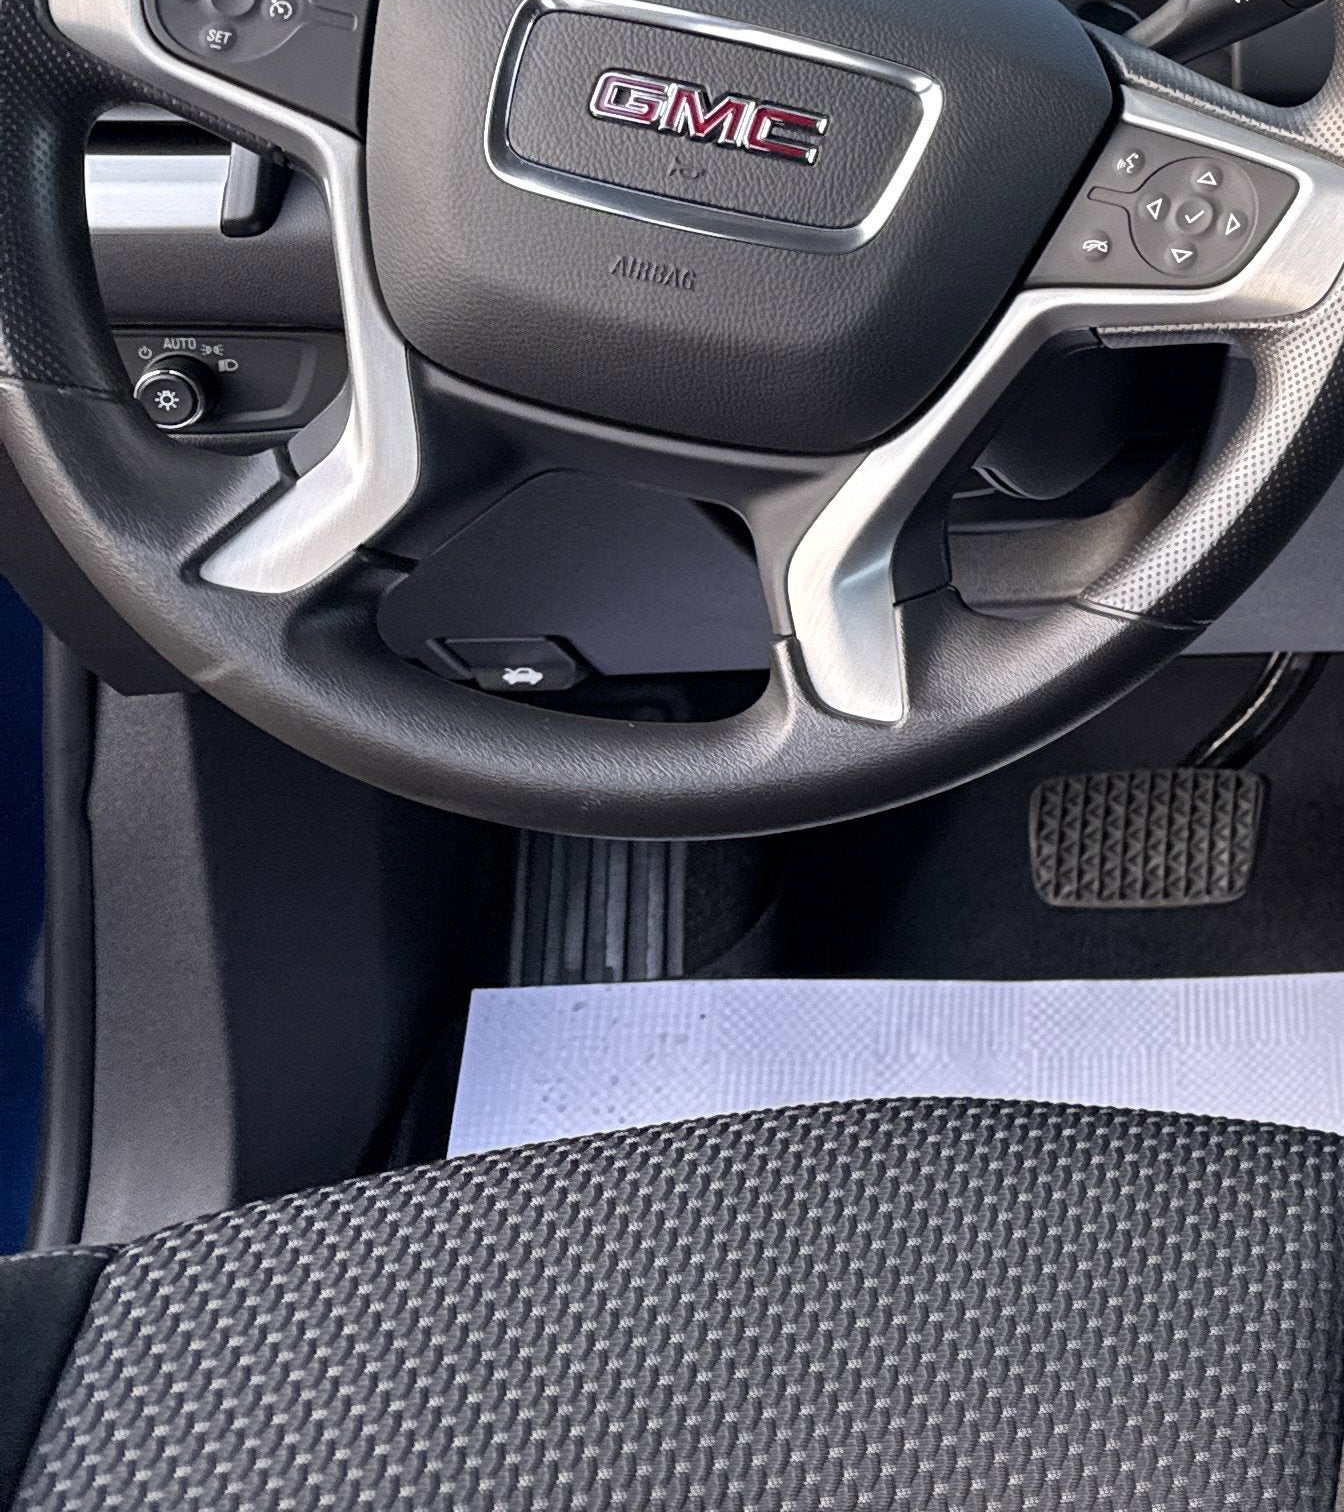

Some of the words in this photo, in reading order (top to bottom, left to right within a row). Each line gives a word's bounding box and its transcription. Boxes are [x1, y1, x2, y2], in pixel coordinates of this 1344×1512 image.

[206, 28, 233, 45] SET
[589, 70, 831, 166] GMC
[609, 254, 697, 291] AIRBAG
[163, 337, 197, 351] AUTO
